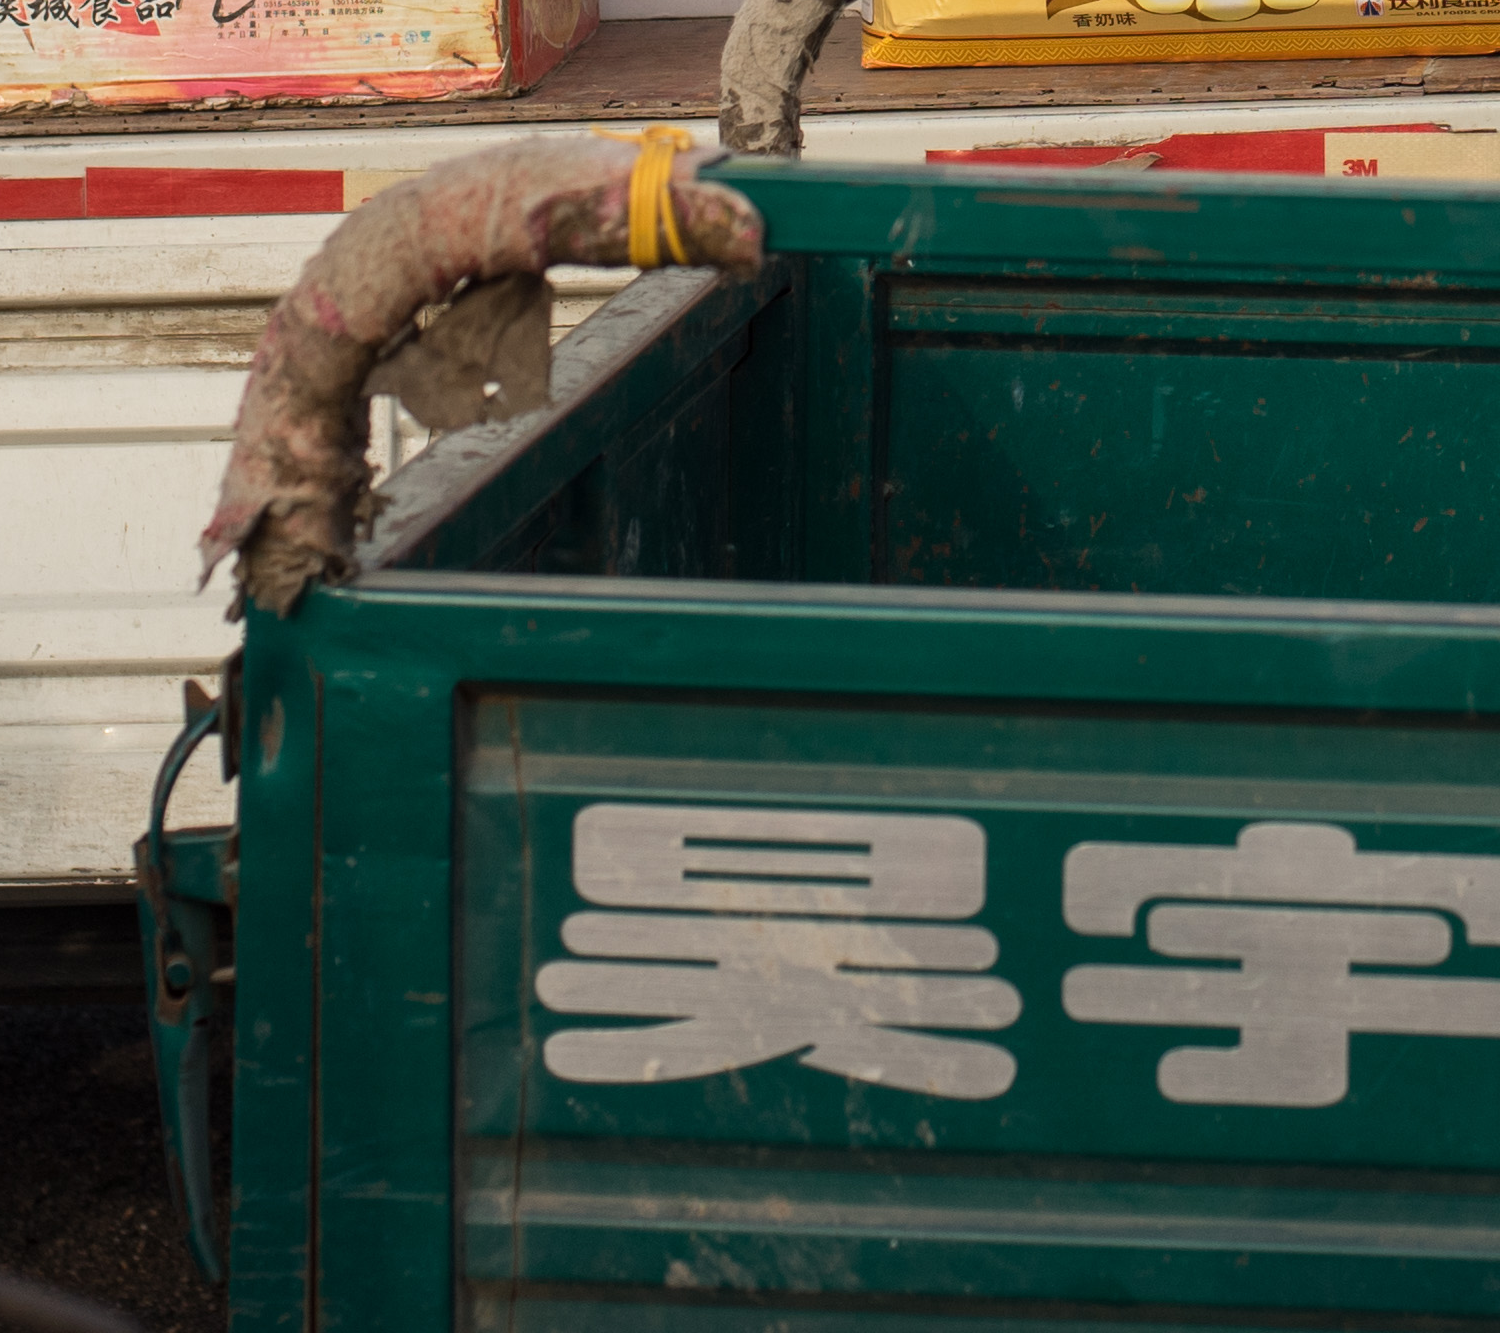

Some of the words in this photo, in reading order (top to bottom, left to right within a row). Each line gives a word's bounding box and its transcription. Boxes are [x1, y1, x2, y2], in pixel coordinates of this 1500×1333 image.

[1072, 11, 1137, 29] 香奶味
[1342, 159, 1378, 177] 3M
